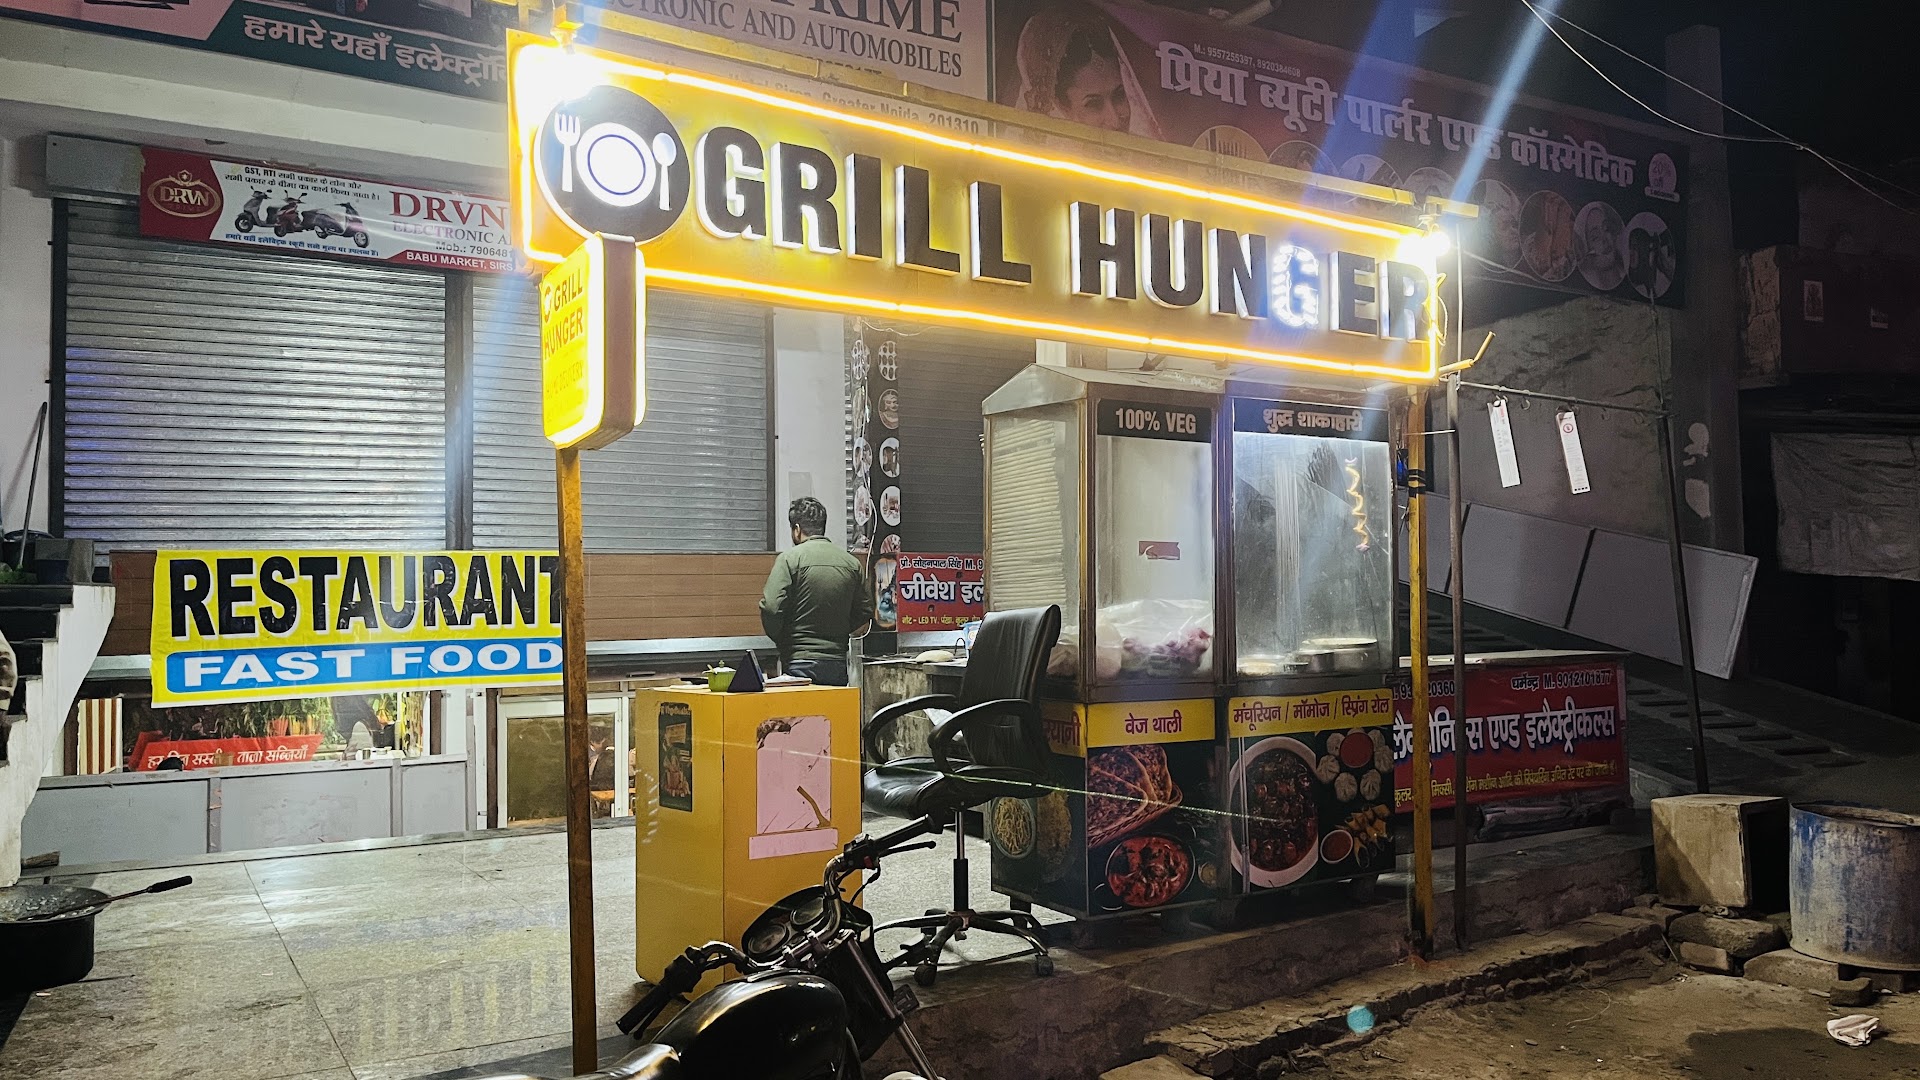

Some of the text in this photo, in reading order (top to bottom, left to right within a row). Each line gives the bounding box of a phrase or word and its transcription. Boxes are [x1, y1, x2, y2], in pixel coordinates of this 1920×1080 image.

[243, 14, 327, 49] हमारे
[330, 31, 392, 61] यहाँ
[605, 0, 735, 29] RONIC
[742, 7, 796, 41] AND
[802, 21, 962, 77] AUTOMOBILES
[773, 0, 962, 43] IME
[1156, 40, 1250, 106] प्रिया
[1254, 76, 1339, 134] ब्यूटी
[1343, 94, 1432, 146] पार्लर
[1437, 115, 1504, 160] एण्ड
[160, 186, 210, 207] DRVN
[389, 190, 508, 231] DRVN
[393, 221, 494, 244] ELECTRONIC
[435, 241, 467, 254] Mob.:
[696, 126, 1430, 343] GRILL HUNGER
[406, 251, 438, 264] BABU
[440, 254, 487, 270] MARKET,
[553, 268, 583, 312] GRILL
[543, 306, 584, 360] HUNGER
[1115, 407, 1197, 434] 100% VEG
[1263, 408, 1363, 433] शुद्ध शाकाहारी
[912, 555, 947, 569] सोहनपाल
[964, 558, 976, 571] M.
[169, 555, 563, 638] RESTAURANT
[899, 572, 956, 601] जीवेश
[184, 641, 564, 687] FAST FOOD
[1543, 674, 1555, 690] M.
[1125, 709, 1183, 735] वेज थाली
[1233, 700, 1281, 732] मंचूरियन
[1293, 697, 1330, 720] मॉमोज
[1341, 694, 1368, 718] स्प्रिंग
[1371, 693, 1391, 714] रोल
[1487, 714, 1521, 750] एण्ड
